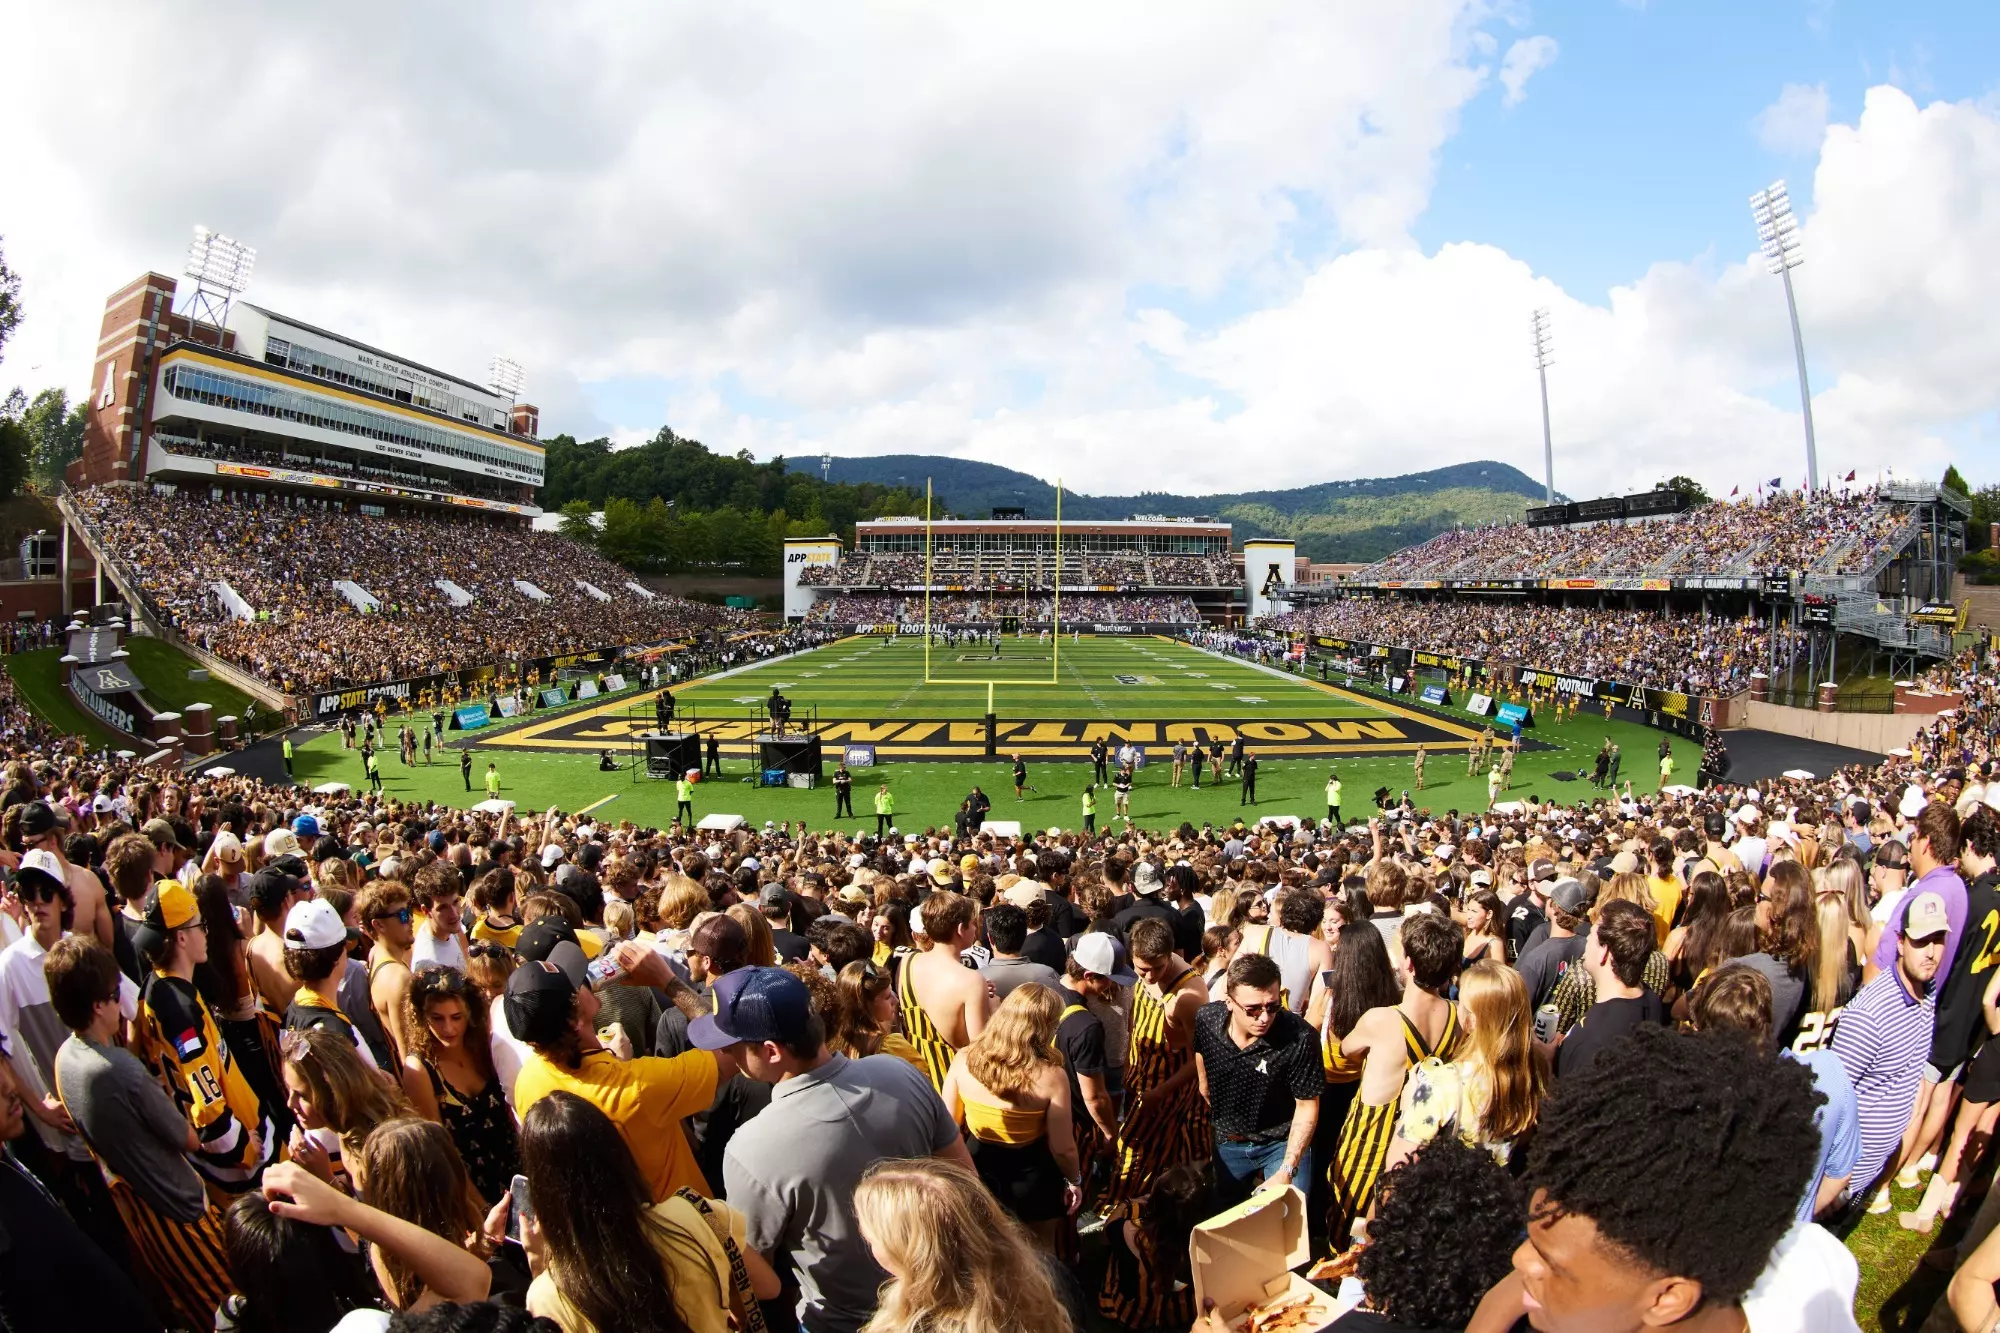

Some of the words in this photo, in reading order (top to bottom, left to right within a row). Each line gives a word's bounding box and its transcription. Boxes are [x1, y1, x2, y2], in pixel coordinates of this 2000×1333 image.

[358, 354, 374, 366] MARK
[401, 368, 427, 383] ATHLETICS
[429, 379, 450, 391] COMPLEX
[1133, 513, 1166, 522] WELCOME
[1260, 563, 1284, 596] A
[1685, 579, 1703, 589] BOWL
[1704, 579, 1743, 589] CHAMPIONS
[1417, 653, 1439, 667] WELCOME
[97, 669, 131, 690] A
[1556, 676, 1594, 697] FOOTBALL
[1699, 700, 1714, 723] A
[1511, 905, 1529, 921] 22
[1970, 909, 2000, 975] 2
[191, 1063, 223, 1107] 18
[675, 1186, 713, 1214] APP
[724, 1236, 751, 1293] NEERS
[743, 1293, 767, 1332] ROLL
